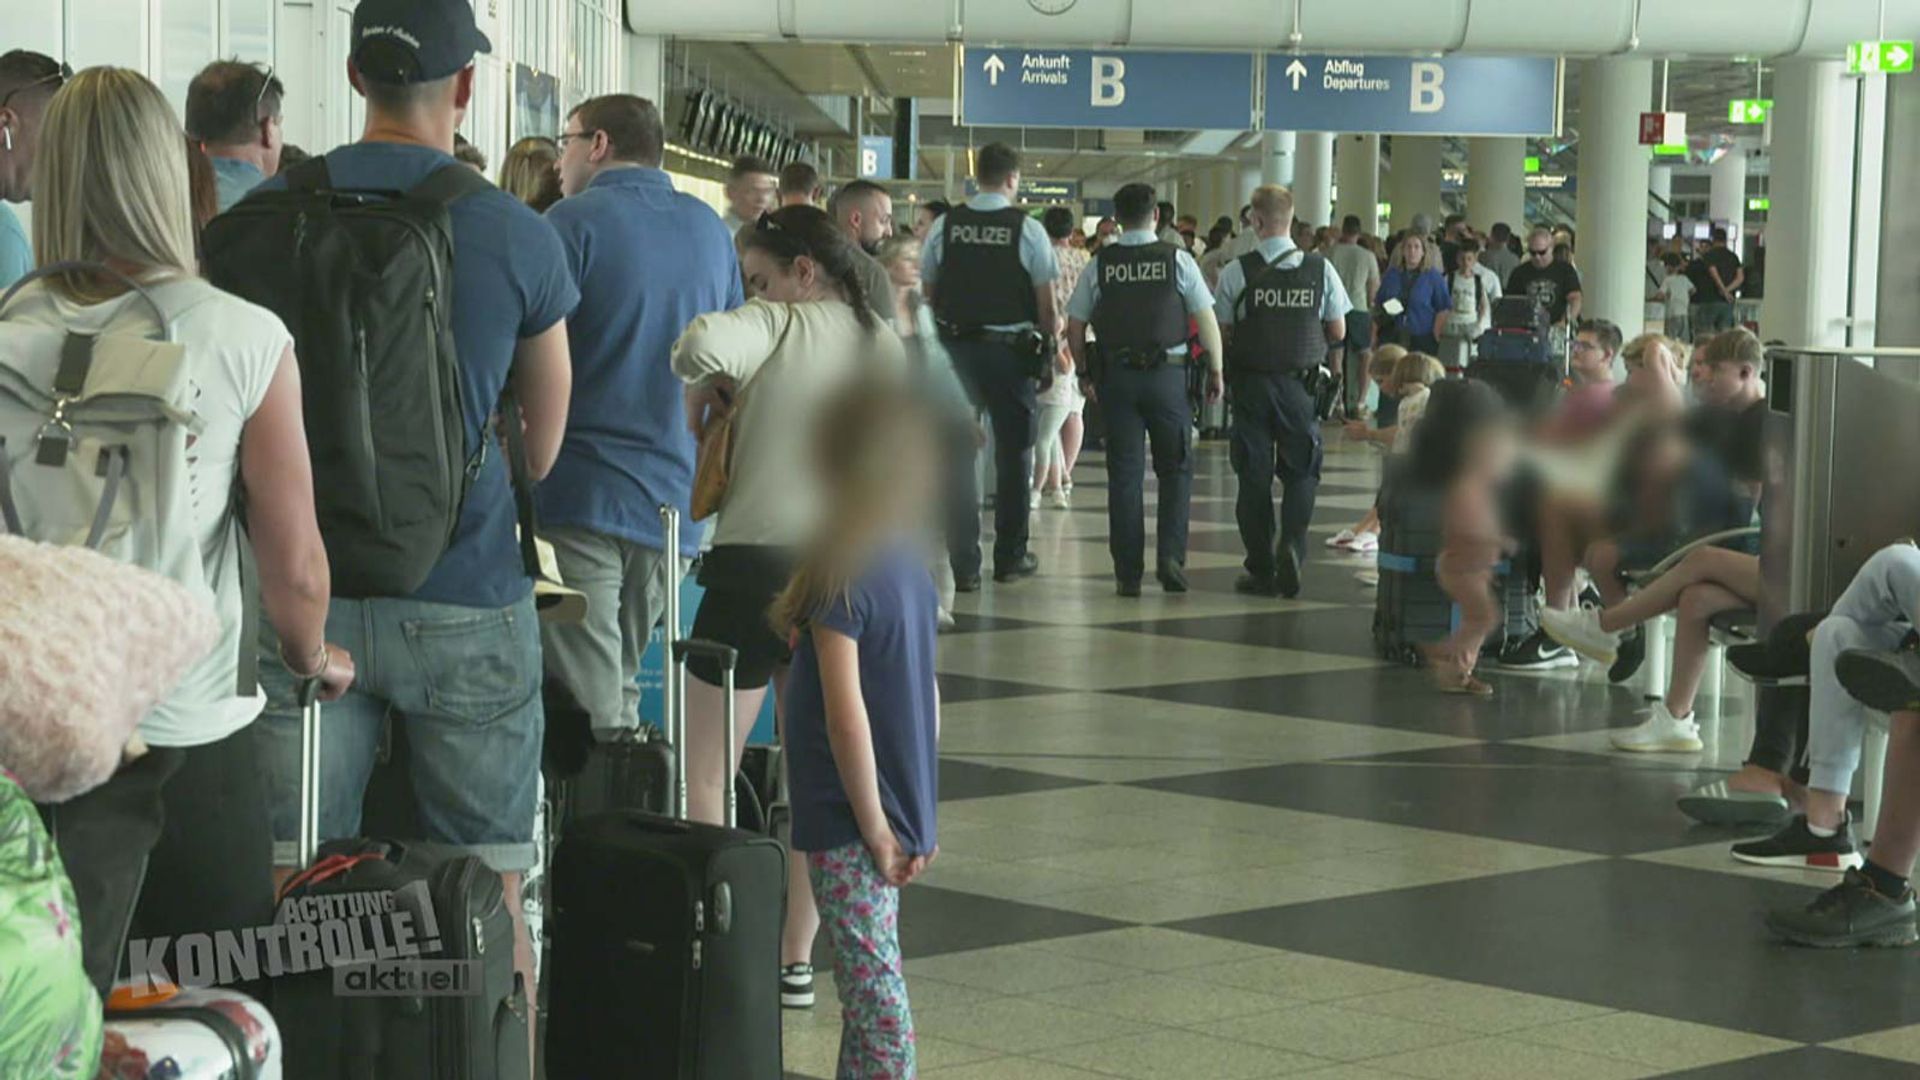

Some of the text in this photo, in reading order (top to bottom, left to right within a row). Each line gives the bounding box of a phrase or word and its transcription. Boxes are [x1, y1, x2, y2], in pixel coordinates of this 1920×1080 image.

[1022, 53, 1070, 69] Ankunft
[1324, 59, 1364, 77] Abflug
[1022, 69, 1068, 84] Arrivals
[1091, 56, 1125, 107] B
[1323, 75, 1391, 92] Departures
[1409, 62, 1445, 113] B
[863, 149, 877, 176] B
[950, 224, 1012, 246] POLIZEI
[1105, 262, 1167, 282] POLIZEI
[1254, 288, 1315, 308] POLIZEI
